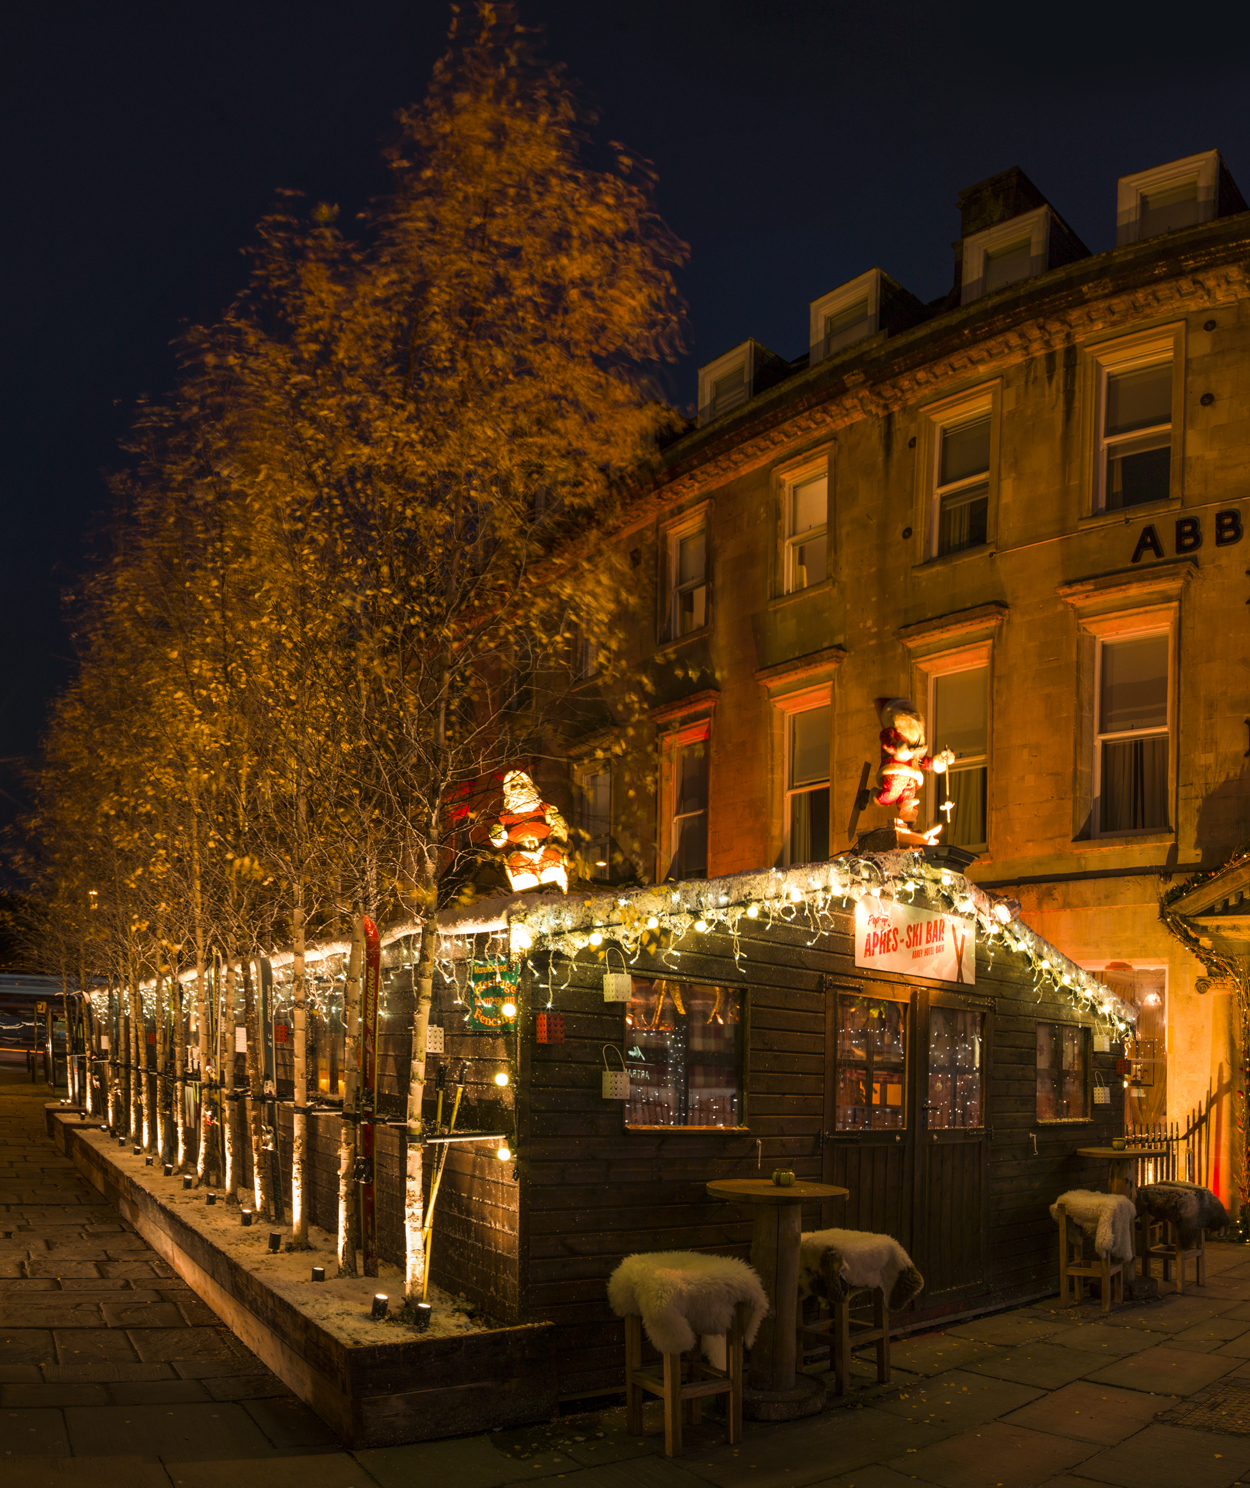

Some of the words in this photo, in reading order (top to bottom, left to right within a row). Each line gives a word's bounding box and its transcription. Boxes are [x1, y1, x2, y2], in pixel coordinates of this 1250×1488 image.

[925, 919, 946, 945] BAR
[366, 965, 375, 1027] ROSSIGNOL
[473, 975, 517, 995] Heritage
